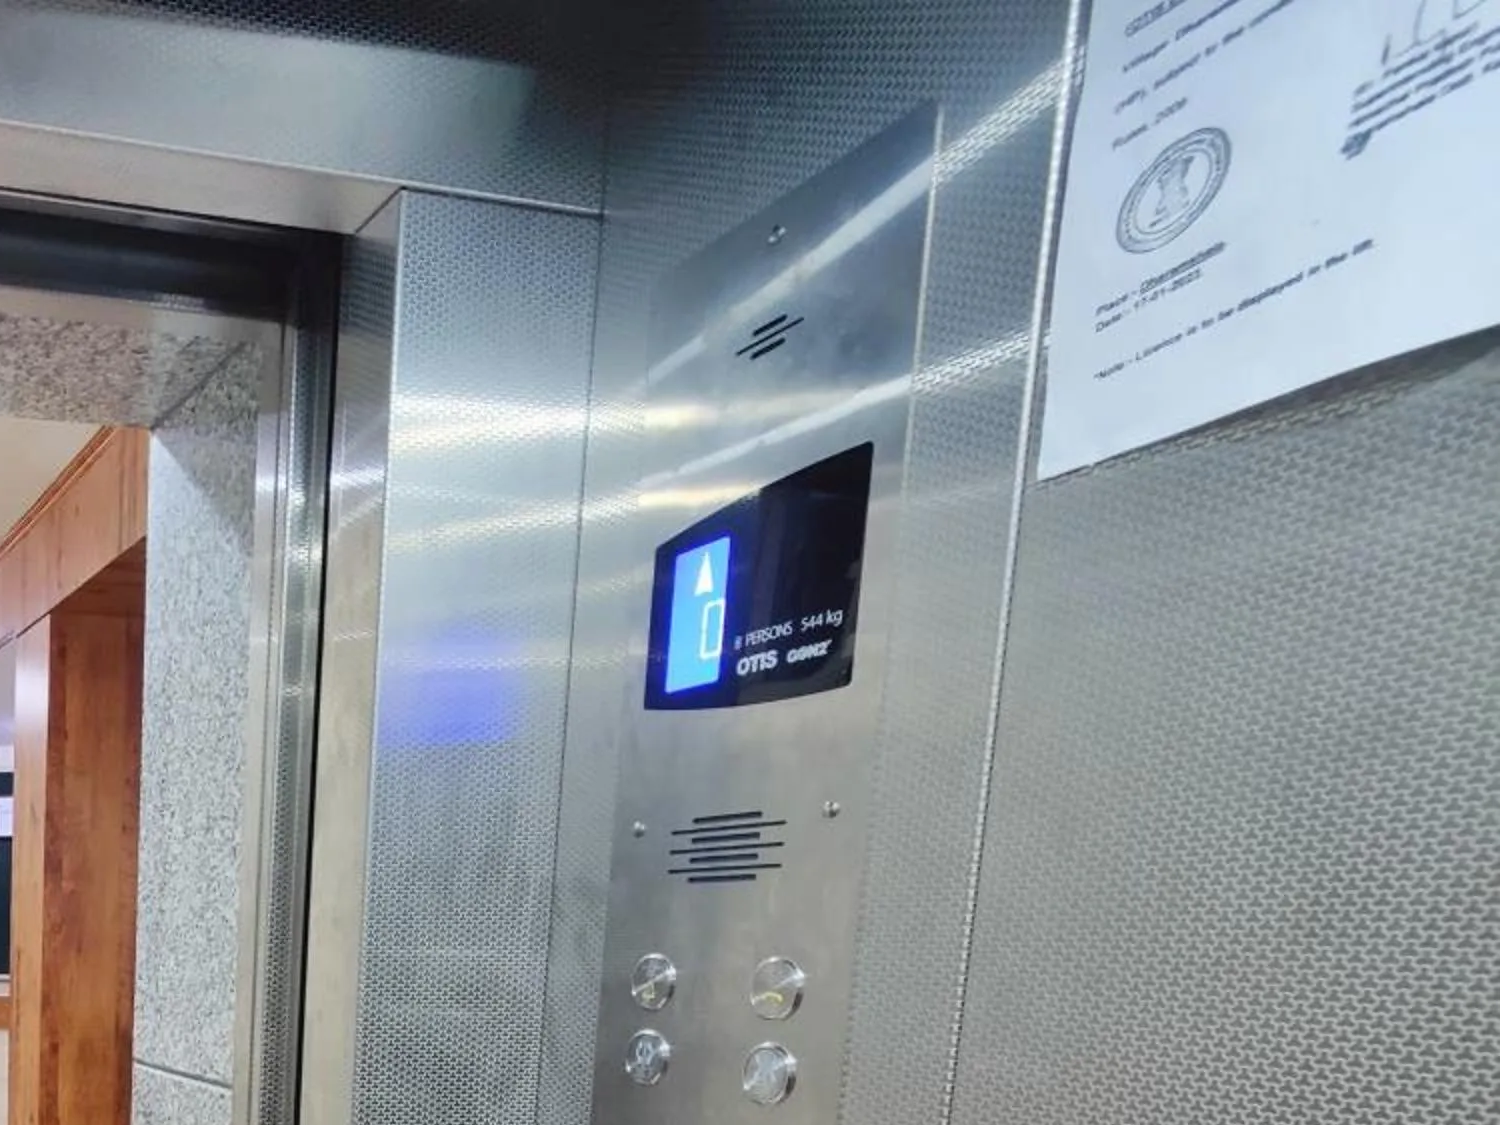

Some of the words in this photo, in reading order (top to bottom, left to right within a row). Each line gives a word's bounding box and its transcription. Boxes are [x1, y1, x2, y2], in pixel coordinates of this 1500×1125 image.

[745, 620, 794, 647] PERSONS
[800, 613, 824, 633] 544
[825, 607, 844, 628] kg
[736, 649, 779, 677] OTIS
